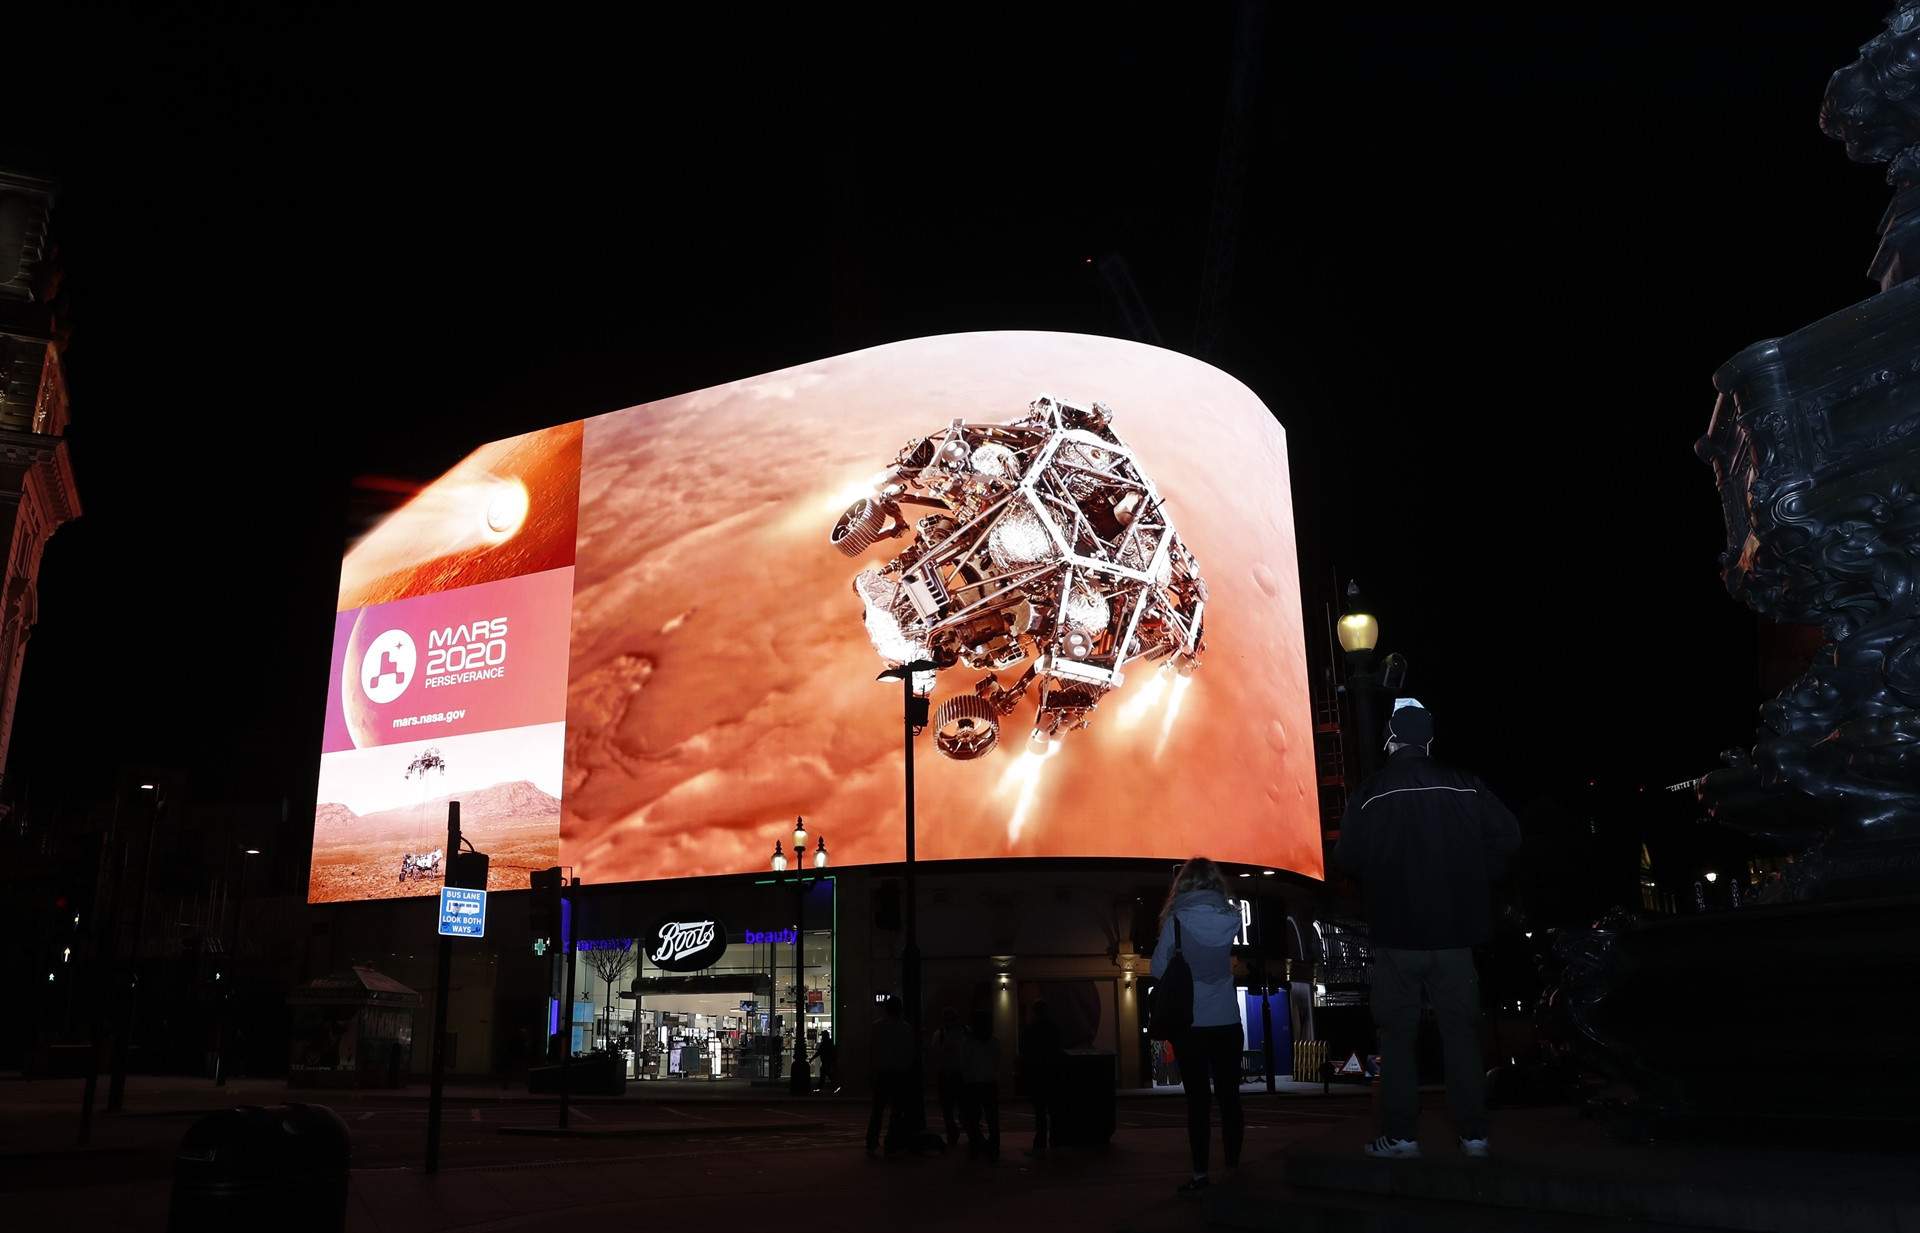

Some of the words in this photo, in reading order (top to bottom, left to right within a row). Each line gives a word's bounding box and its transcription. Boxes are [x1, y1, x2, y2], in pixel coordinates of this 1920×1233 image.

[428, 616, 508, 649] MARS
[426, 638, 507, 676] 2020
[425, 666, 505, 689] PERSEVERANCE
[392, 709, 466, 728] mars.nasa.gov
[446, 890, 462, 899] BUS
[462, 892, 481, 901] LANE
[442, 915, 462, 924] LOOK
[462, 916, 482, 925] BOTH
[452, 925, 472, 934] WAYS
[651, 919, 715, 961] Boots
[745, 927, 798, 946] beauty
